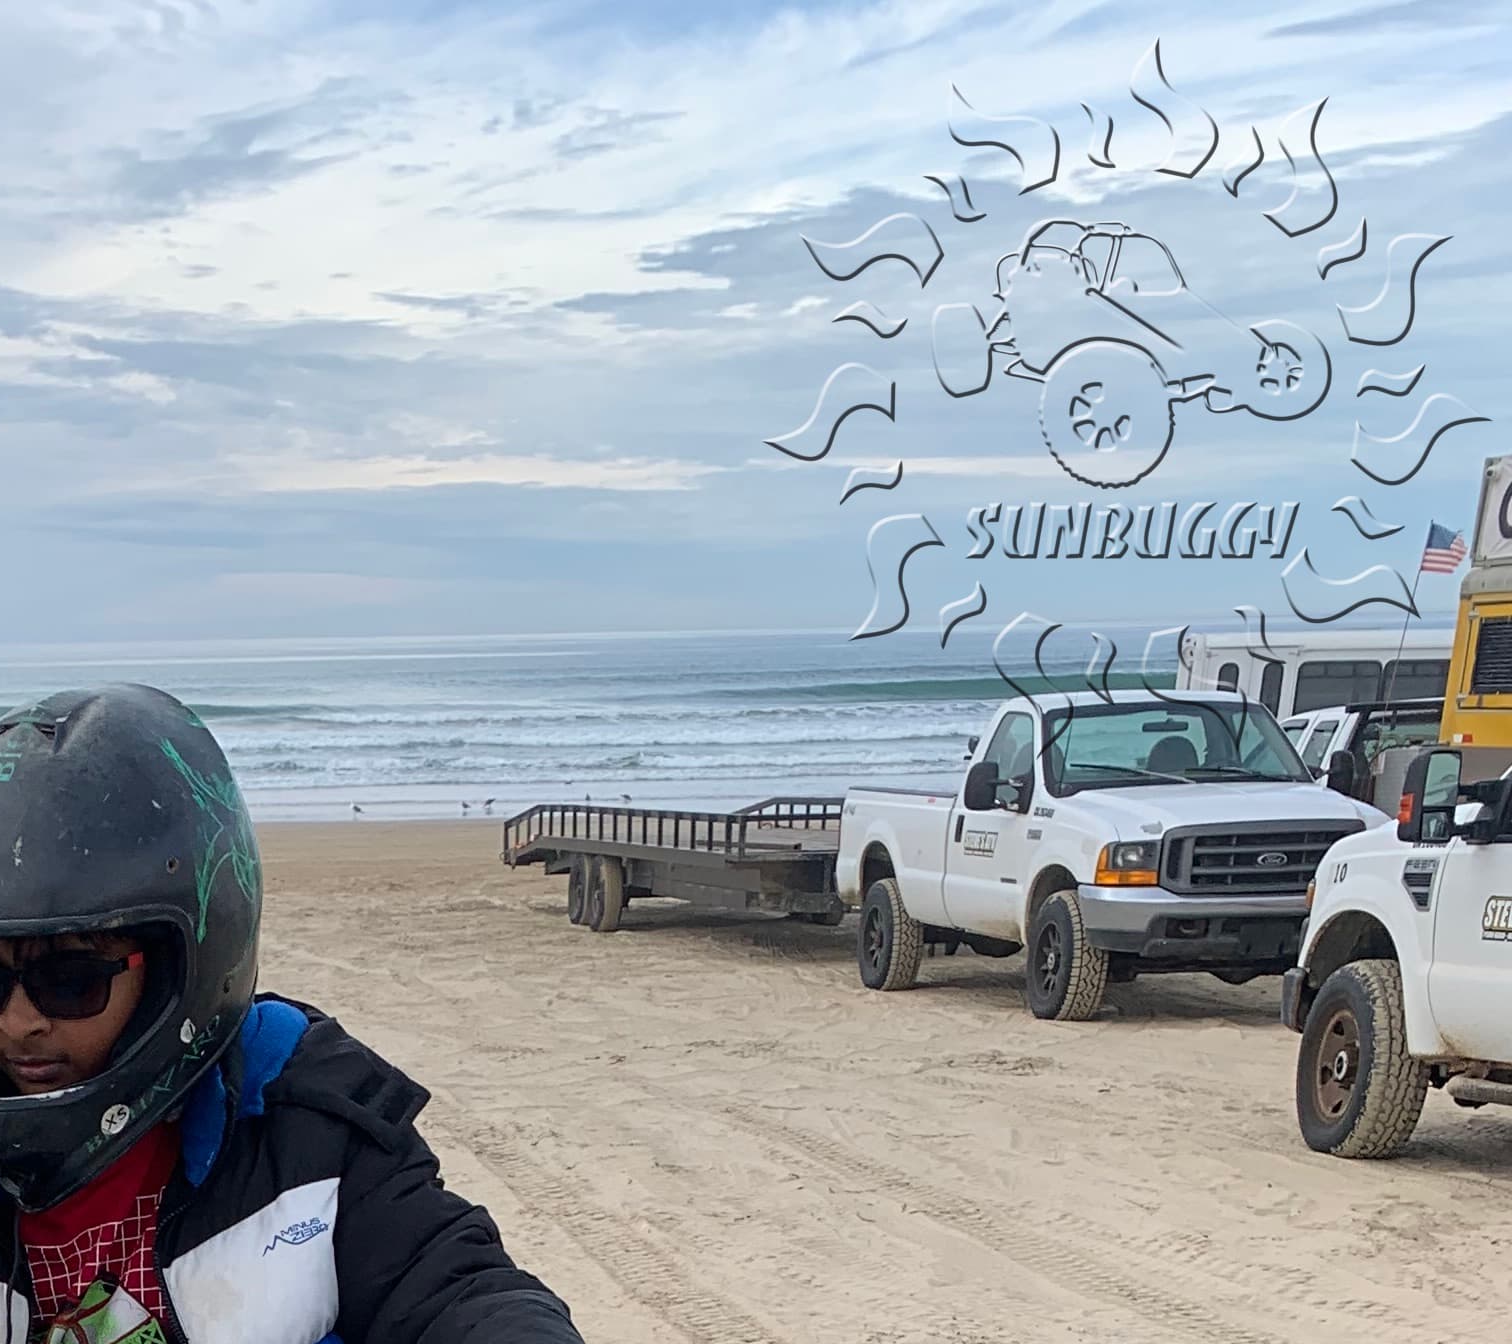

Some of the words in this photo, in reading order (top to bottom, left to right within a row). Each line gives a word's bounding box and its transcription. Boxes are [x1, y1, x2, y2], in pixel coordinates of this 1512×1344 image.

[1333, 863, 1348, 884] 10
[280, 1217, 320, 1237] MINUS
[290, 1222, 329, 1242] ZERO
